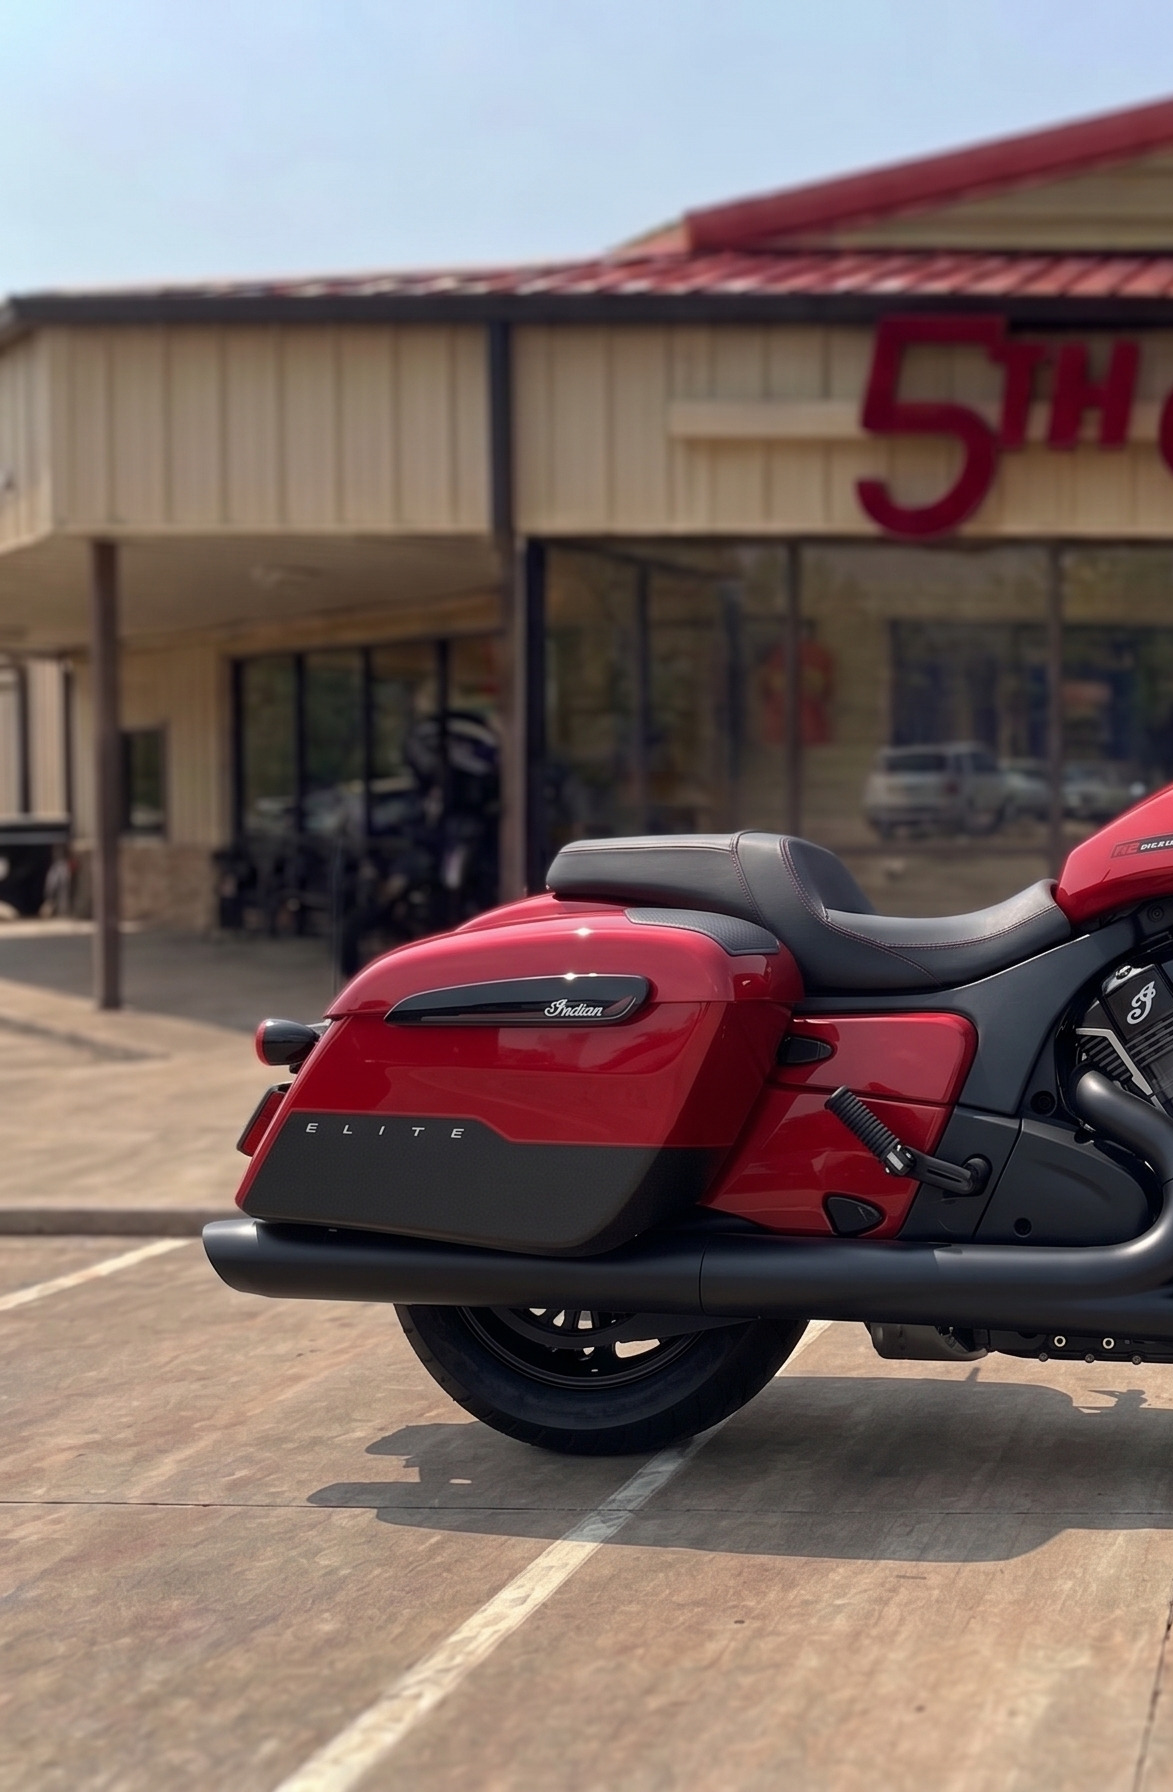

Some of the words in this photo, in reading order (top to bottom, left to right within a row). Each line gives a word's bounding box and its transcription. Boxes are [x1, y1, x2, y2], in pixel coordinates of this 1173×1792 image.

[857, 314, 1140, 538] 5TH
[544, 998, 604, 1017] Indian
[305, 1122, 465, 1139] ELITE
